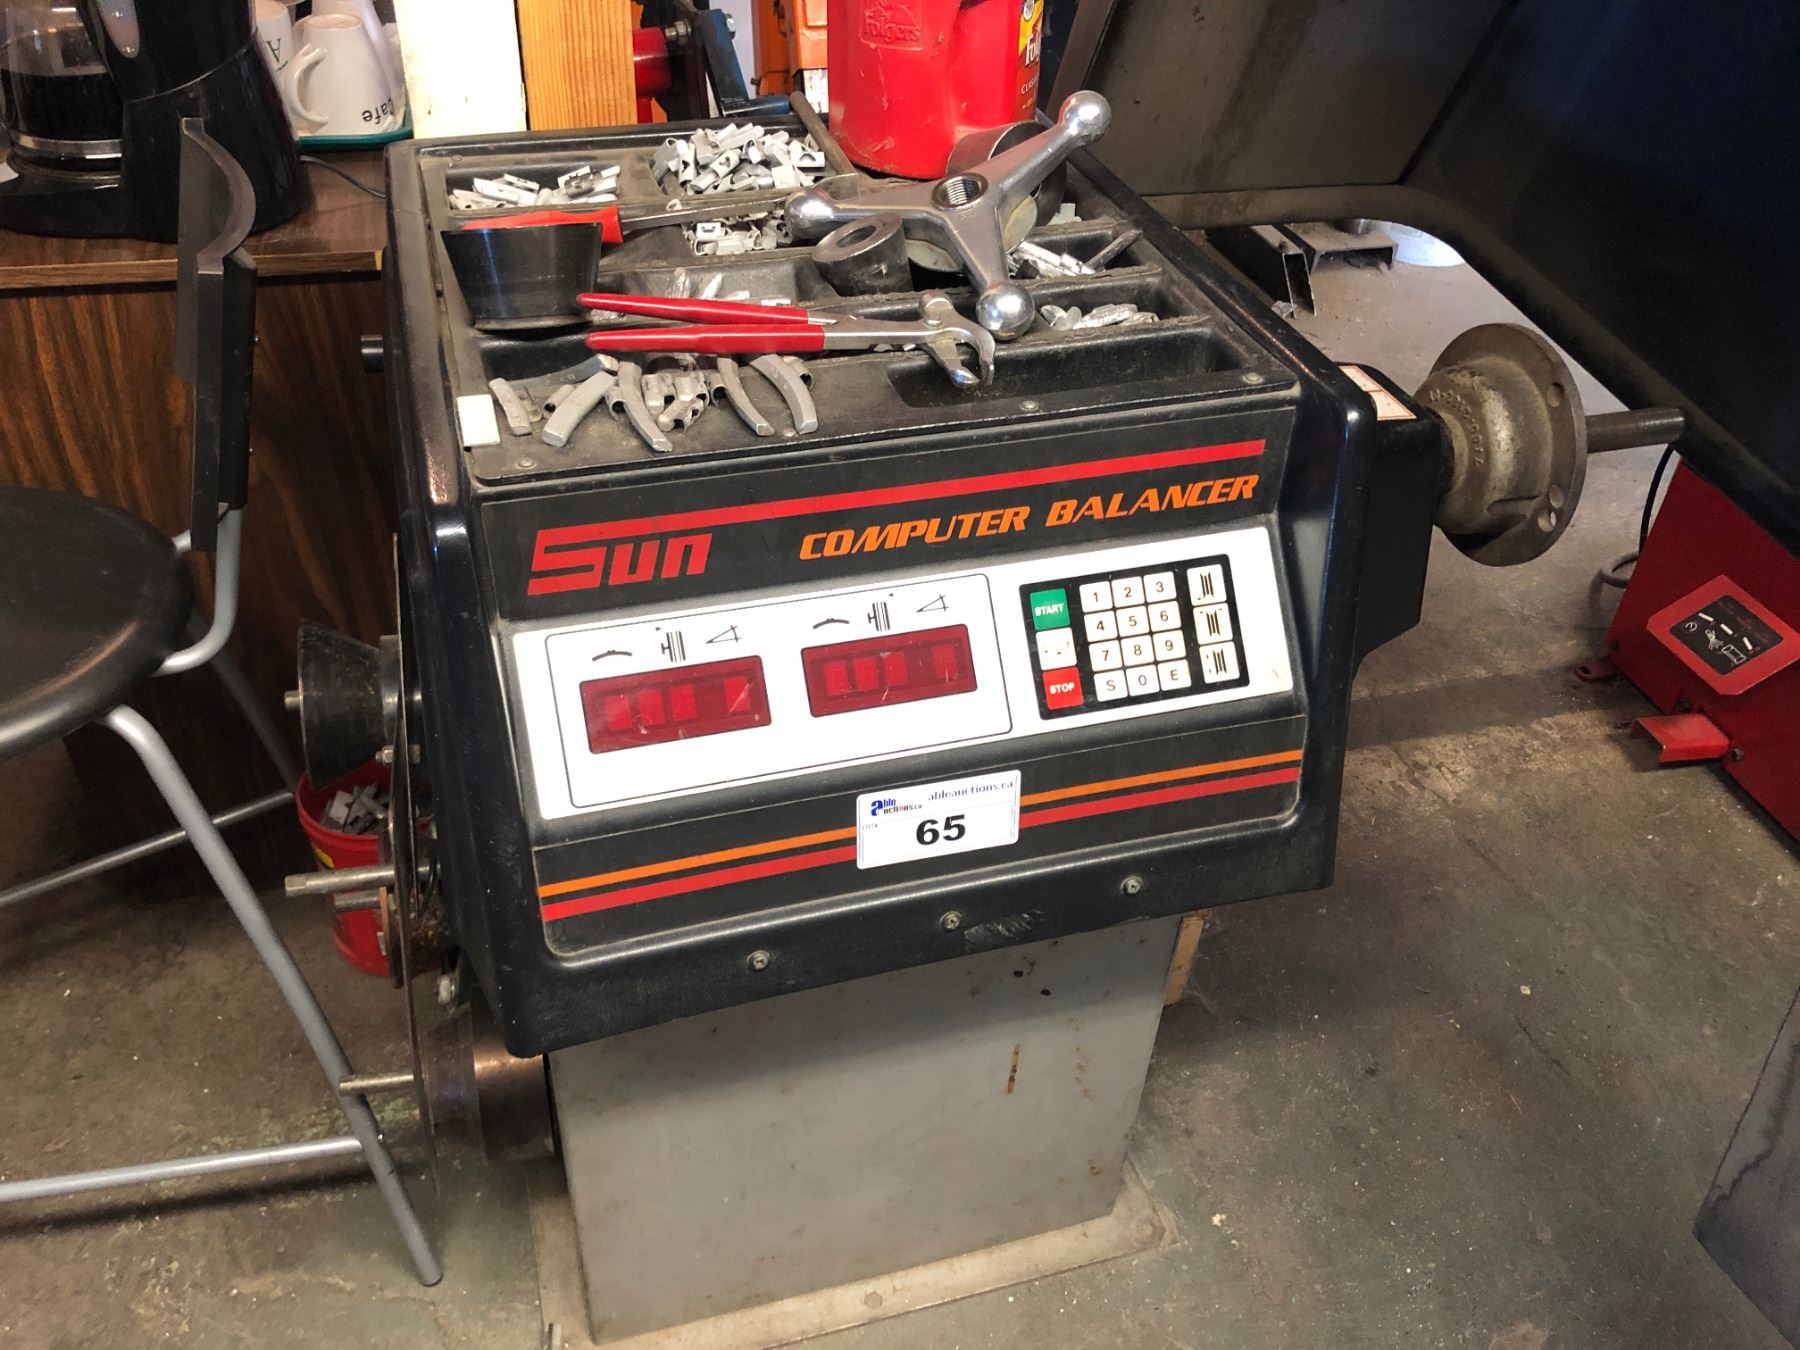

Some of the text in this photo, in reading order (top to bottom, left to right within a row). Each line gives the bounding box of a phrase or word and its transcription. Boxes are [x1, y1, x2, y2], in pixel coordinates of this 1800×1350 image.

[800, 474, 1259, 560] COMPUTER BALANCER
[1092, 581, 1164, 602] 1 2 3
[1034, 602, 1064, 616] START
[1096, 610, 1169, 632] 4 5 6
[1102, 639, 1174, 662] 7 8 9
[1049, 682, 1075, 695] STOP
[1106, 679, 1116, 691] S
[1170, 669, 1179, 681] E
[927, 781, 1014, 801] ableauctions.ca
[916, 814, 966, 846] 65
